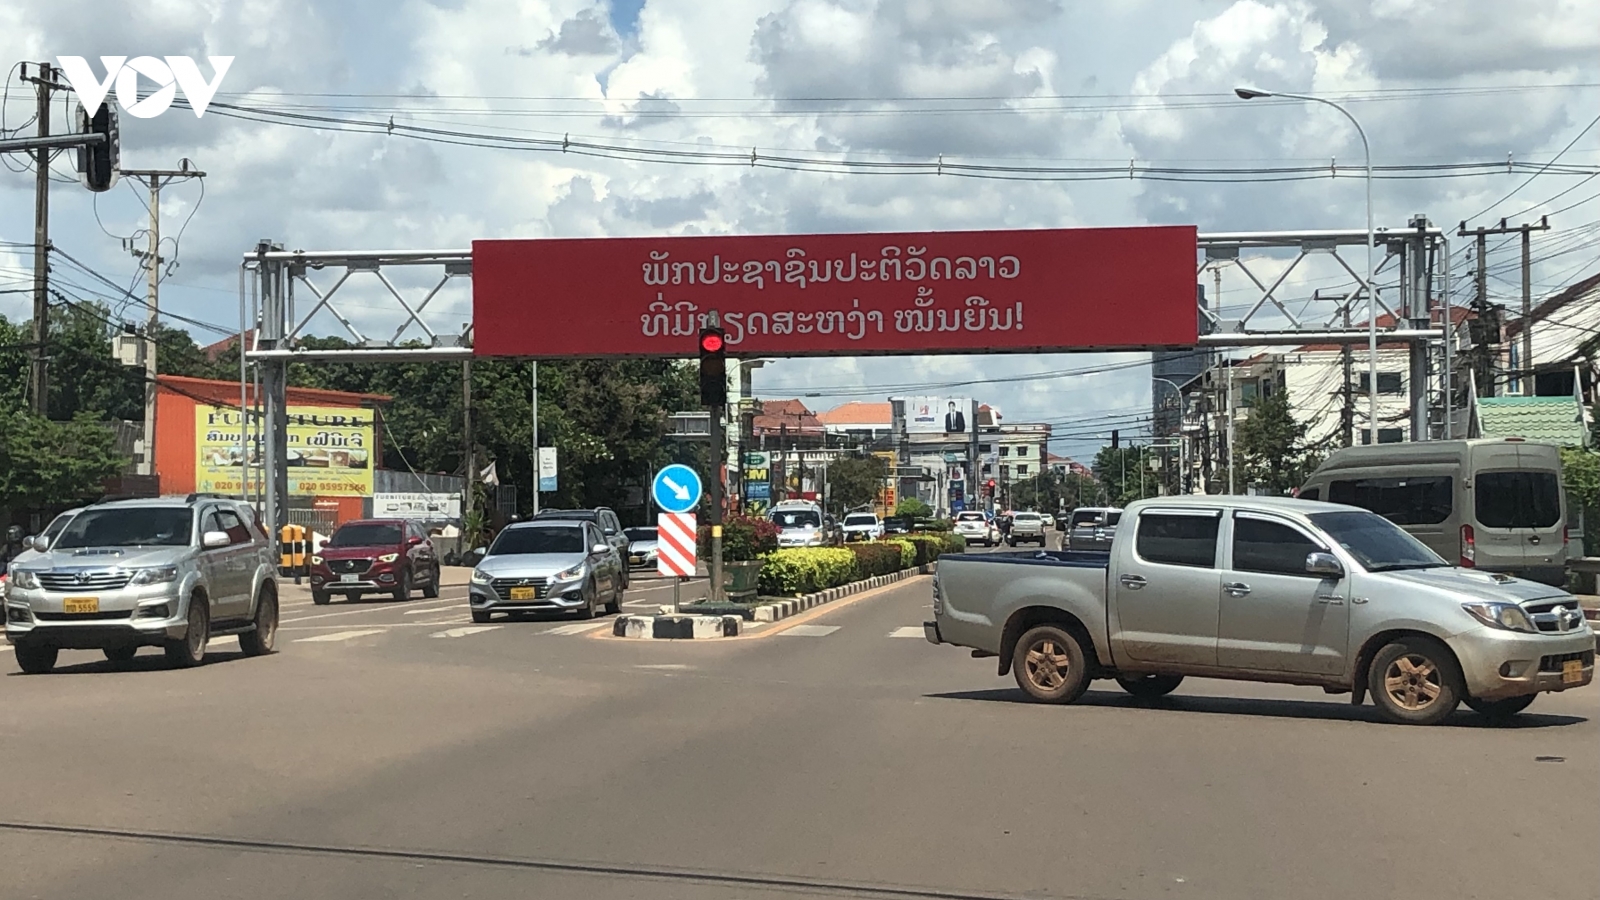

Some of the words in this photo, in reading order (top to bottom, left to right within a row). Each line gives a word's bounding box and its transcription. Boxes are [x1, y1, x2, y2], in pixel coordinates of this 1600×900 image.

[642, 246, 1020, 289] ພັກປະຊາຊົນປະຕິວັດລາວ
[208, 413, 364, 428] FURTURE
[214, 481, 233, 490] 020
[299, 482, 317, 491] 020
